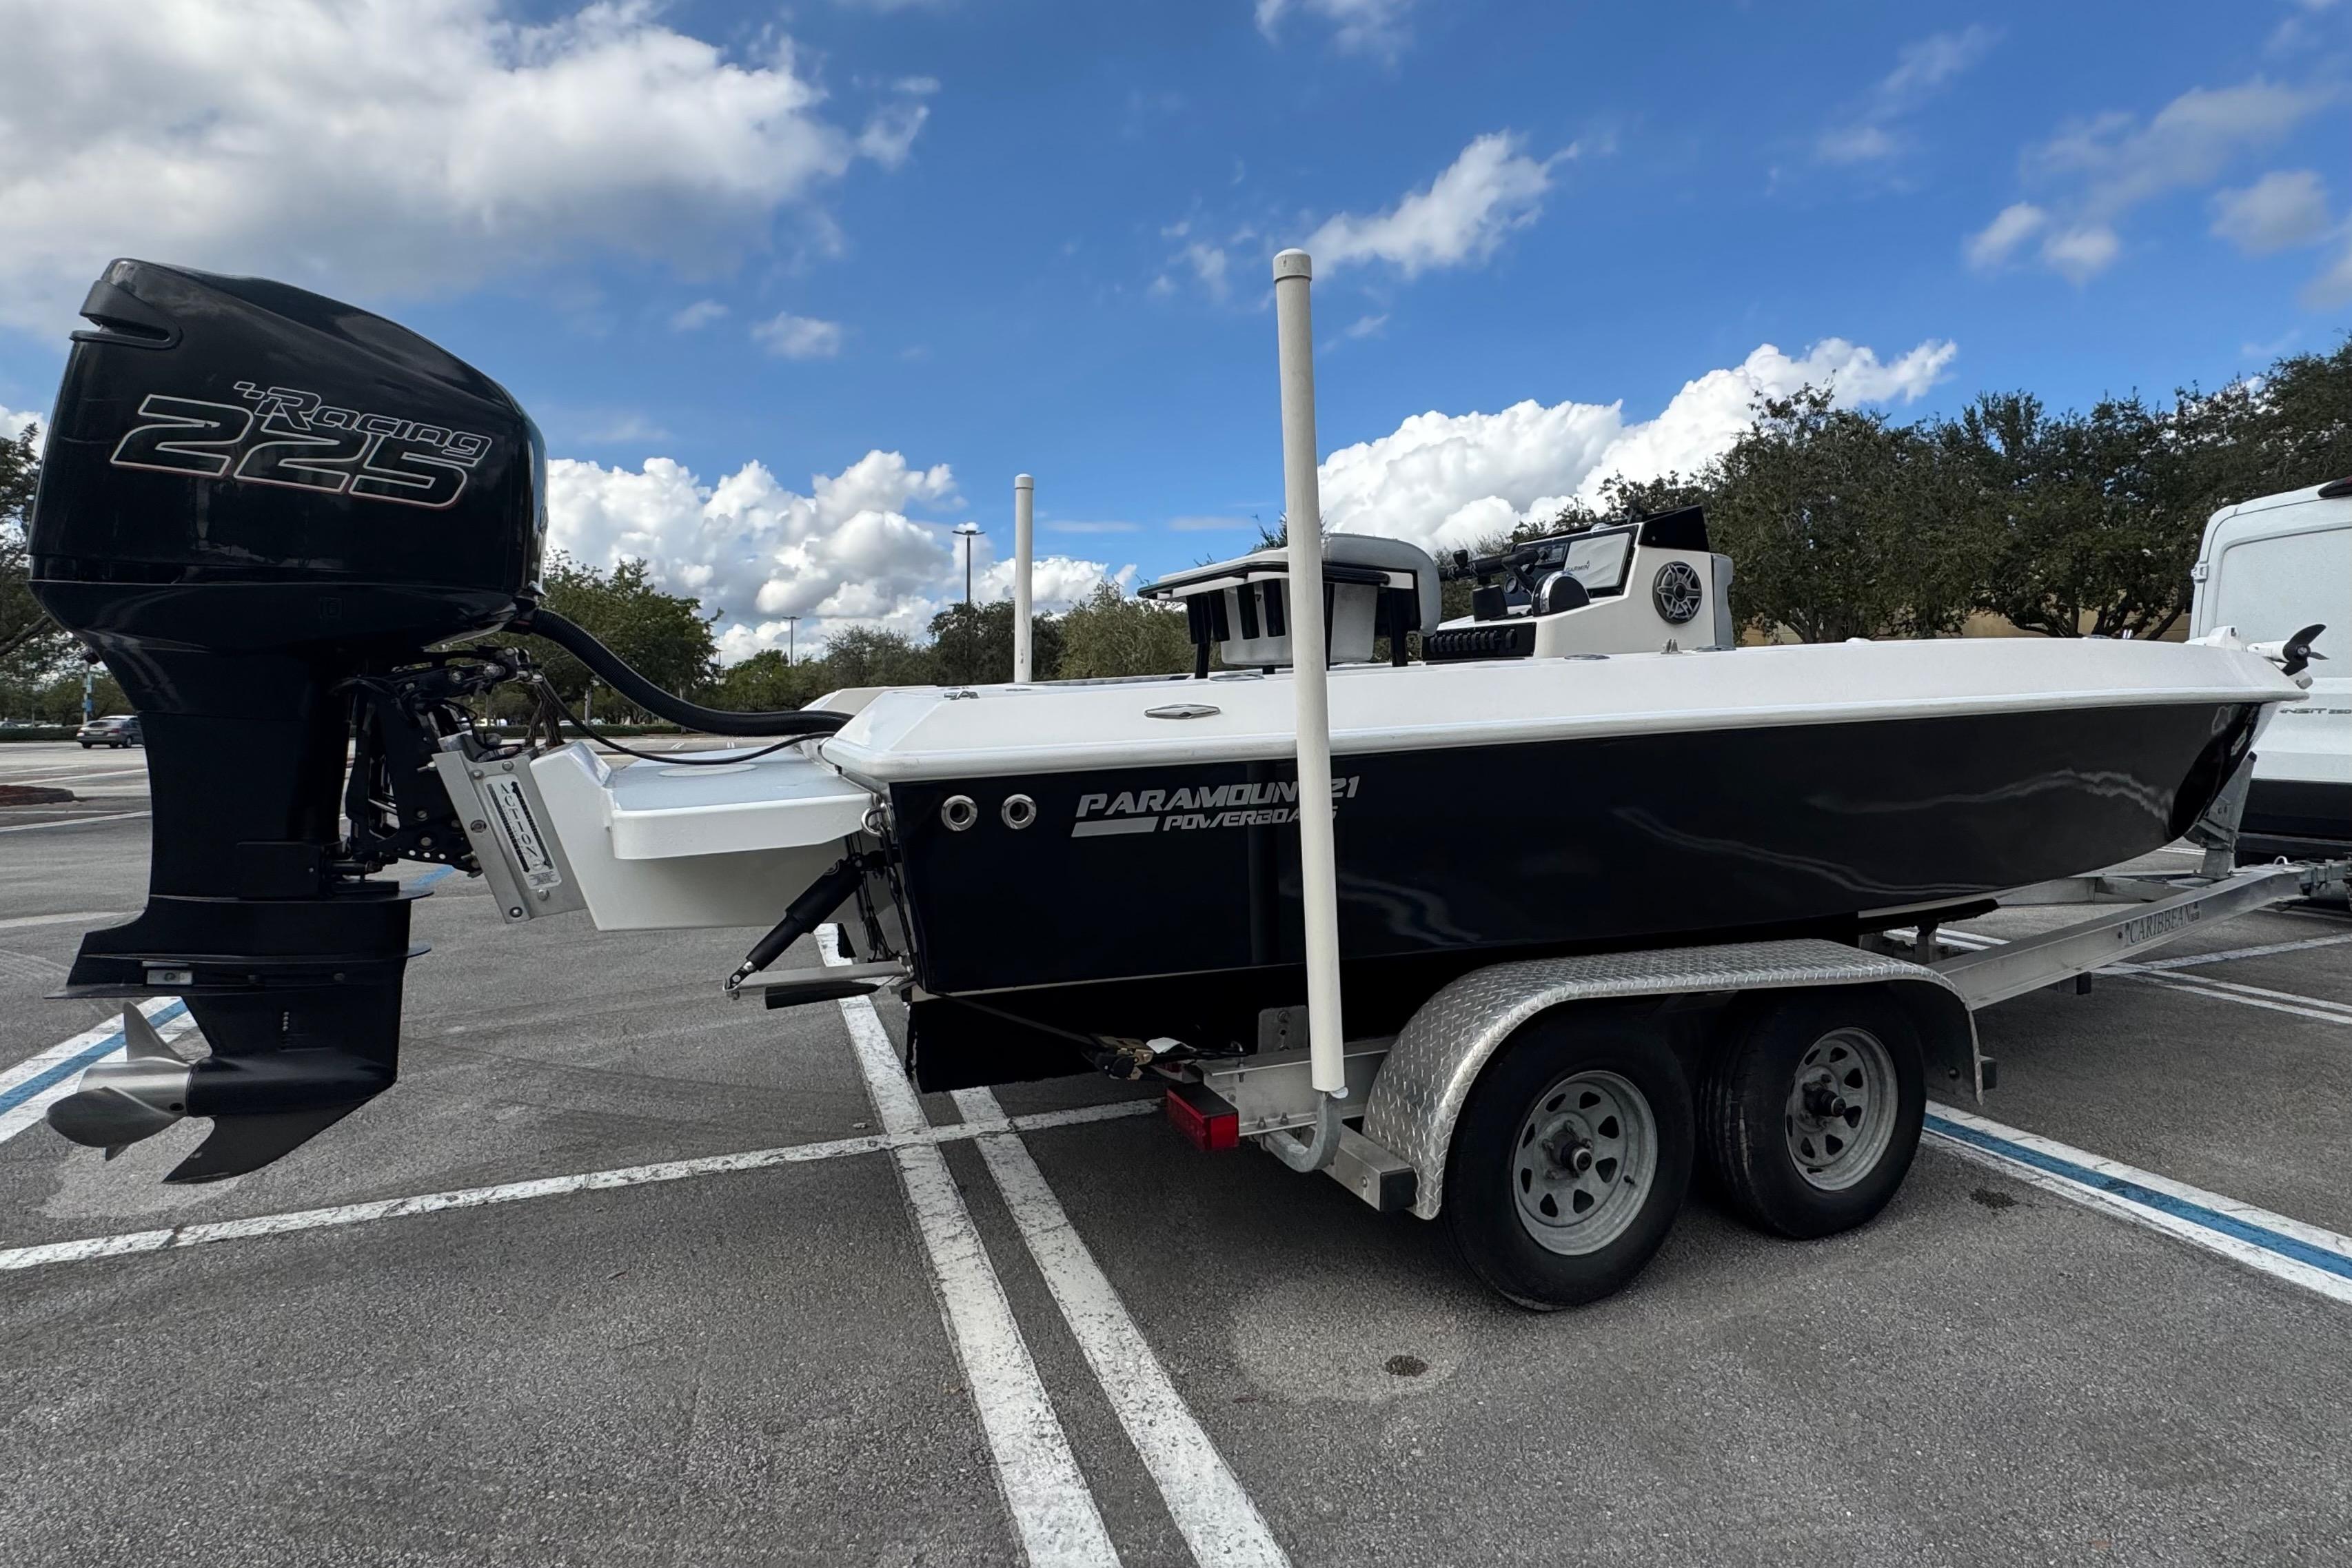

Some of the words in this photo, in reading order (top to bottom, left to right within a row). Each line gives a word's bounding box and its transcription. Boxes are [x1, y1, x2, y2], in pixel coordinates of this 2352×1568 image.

[110, 394, 467, 507] 225
[252, 385, 491, 462] Racing
[501, 783, 538, 857] ACTION
[1075, 781, 1299, 818] PARAMOUN
[2129, 904, 2192, 944] CARIBBEAN
